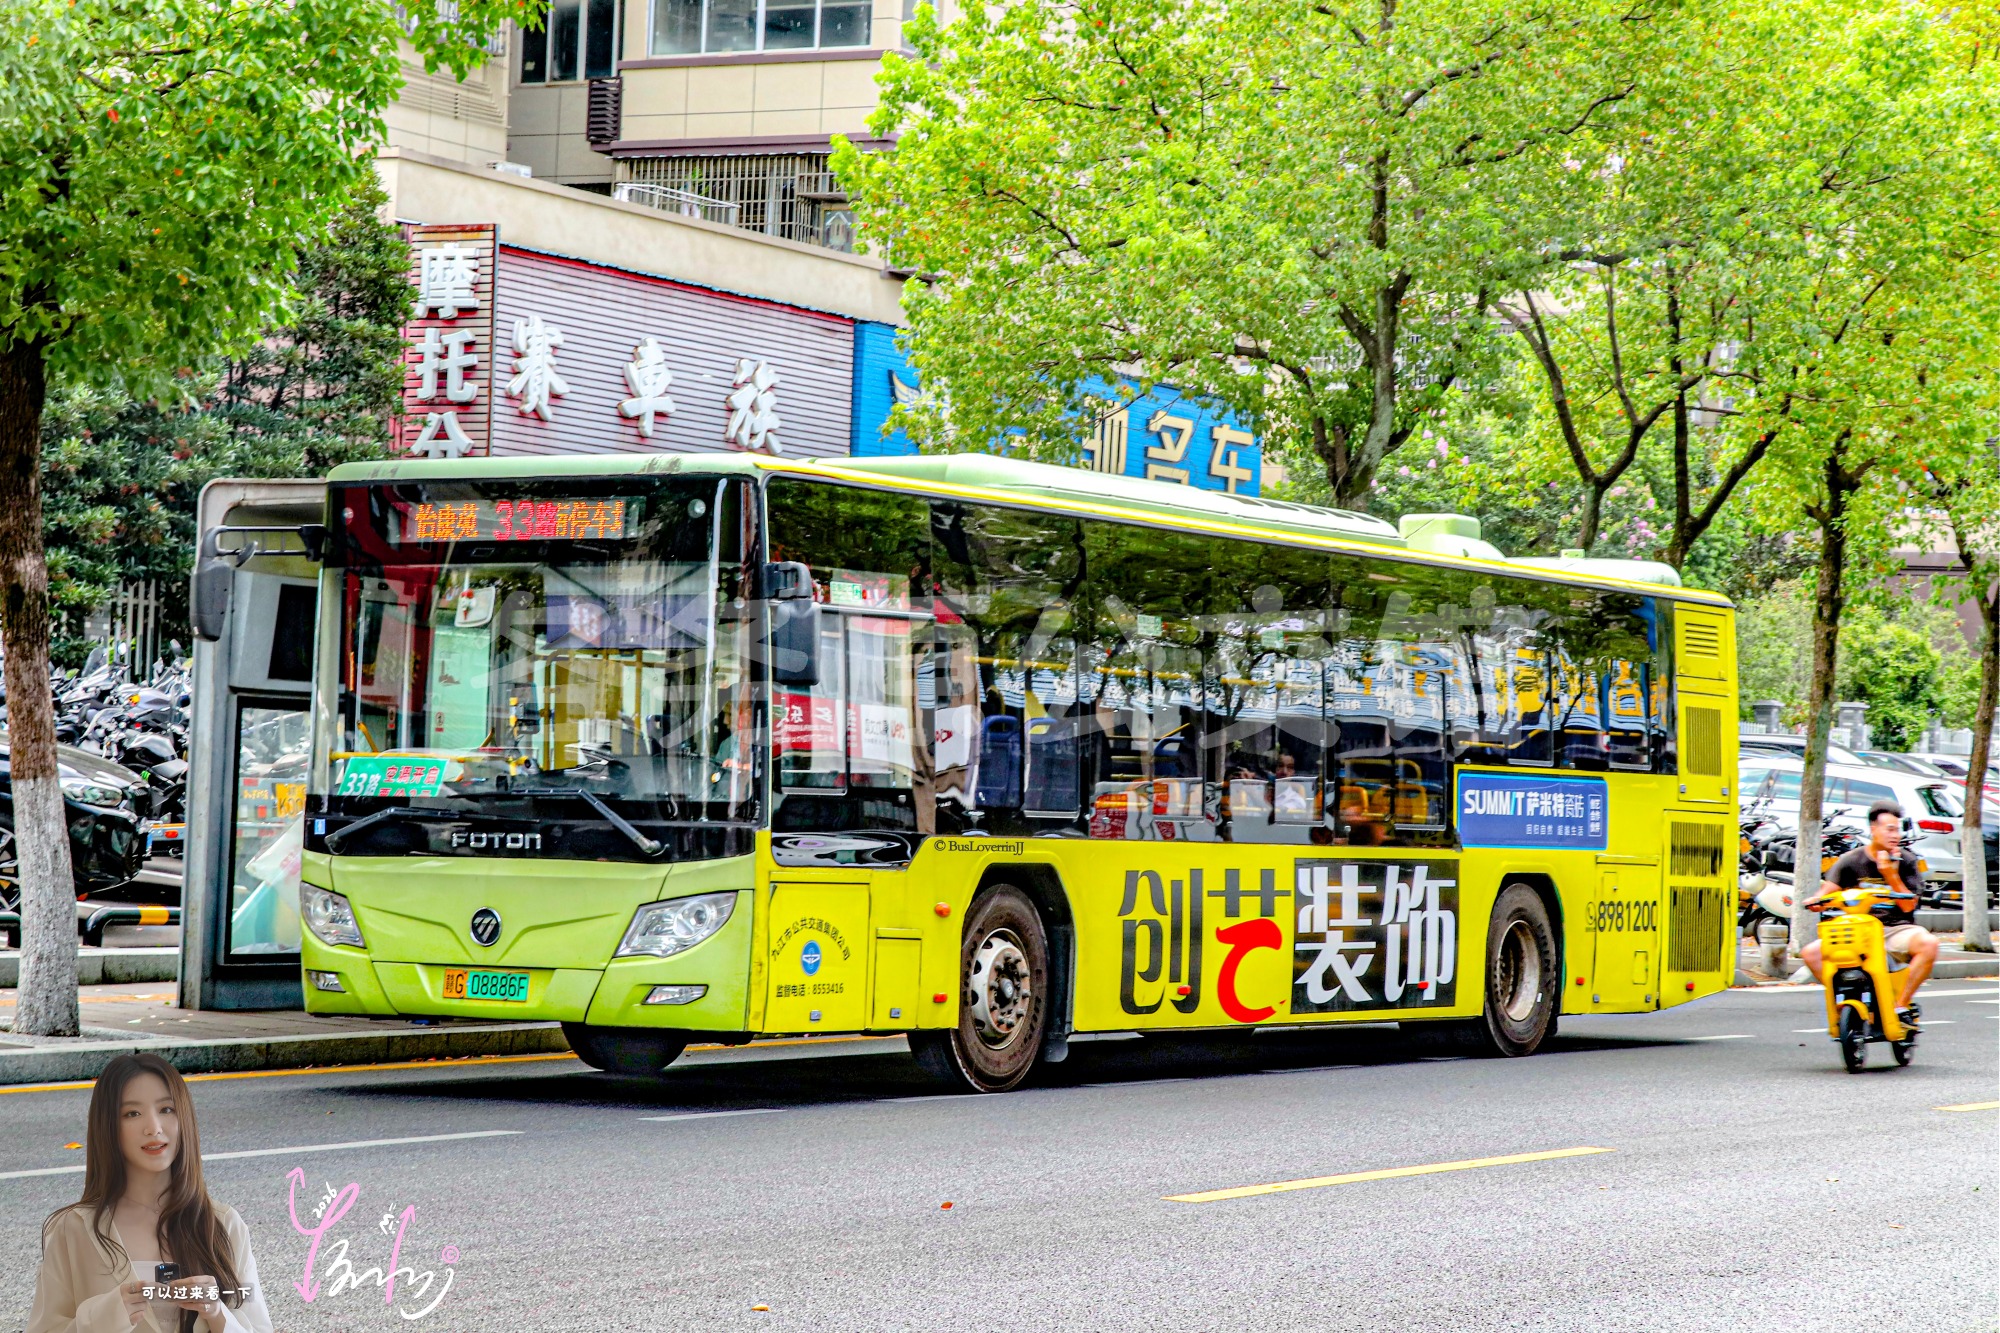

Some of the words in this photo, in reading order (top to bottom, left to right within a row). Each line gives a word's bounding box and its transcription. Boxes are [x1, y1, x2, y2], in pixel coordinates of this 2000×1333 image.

[346, 773, 382, 797] 33路
[384, 765, 440, 785] 空调开启
[452, 832, 542, 850] FOTON
[771, 917, 851, 961] 九江市公共交通集团公司
